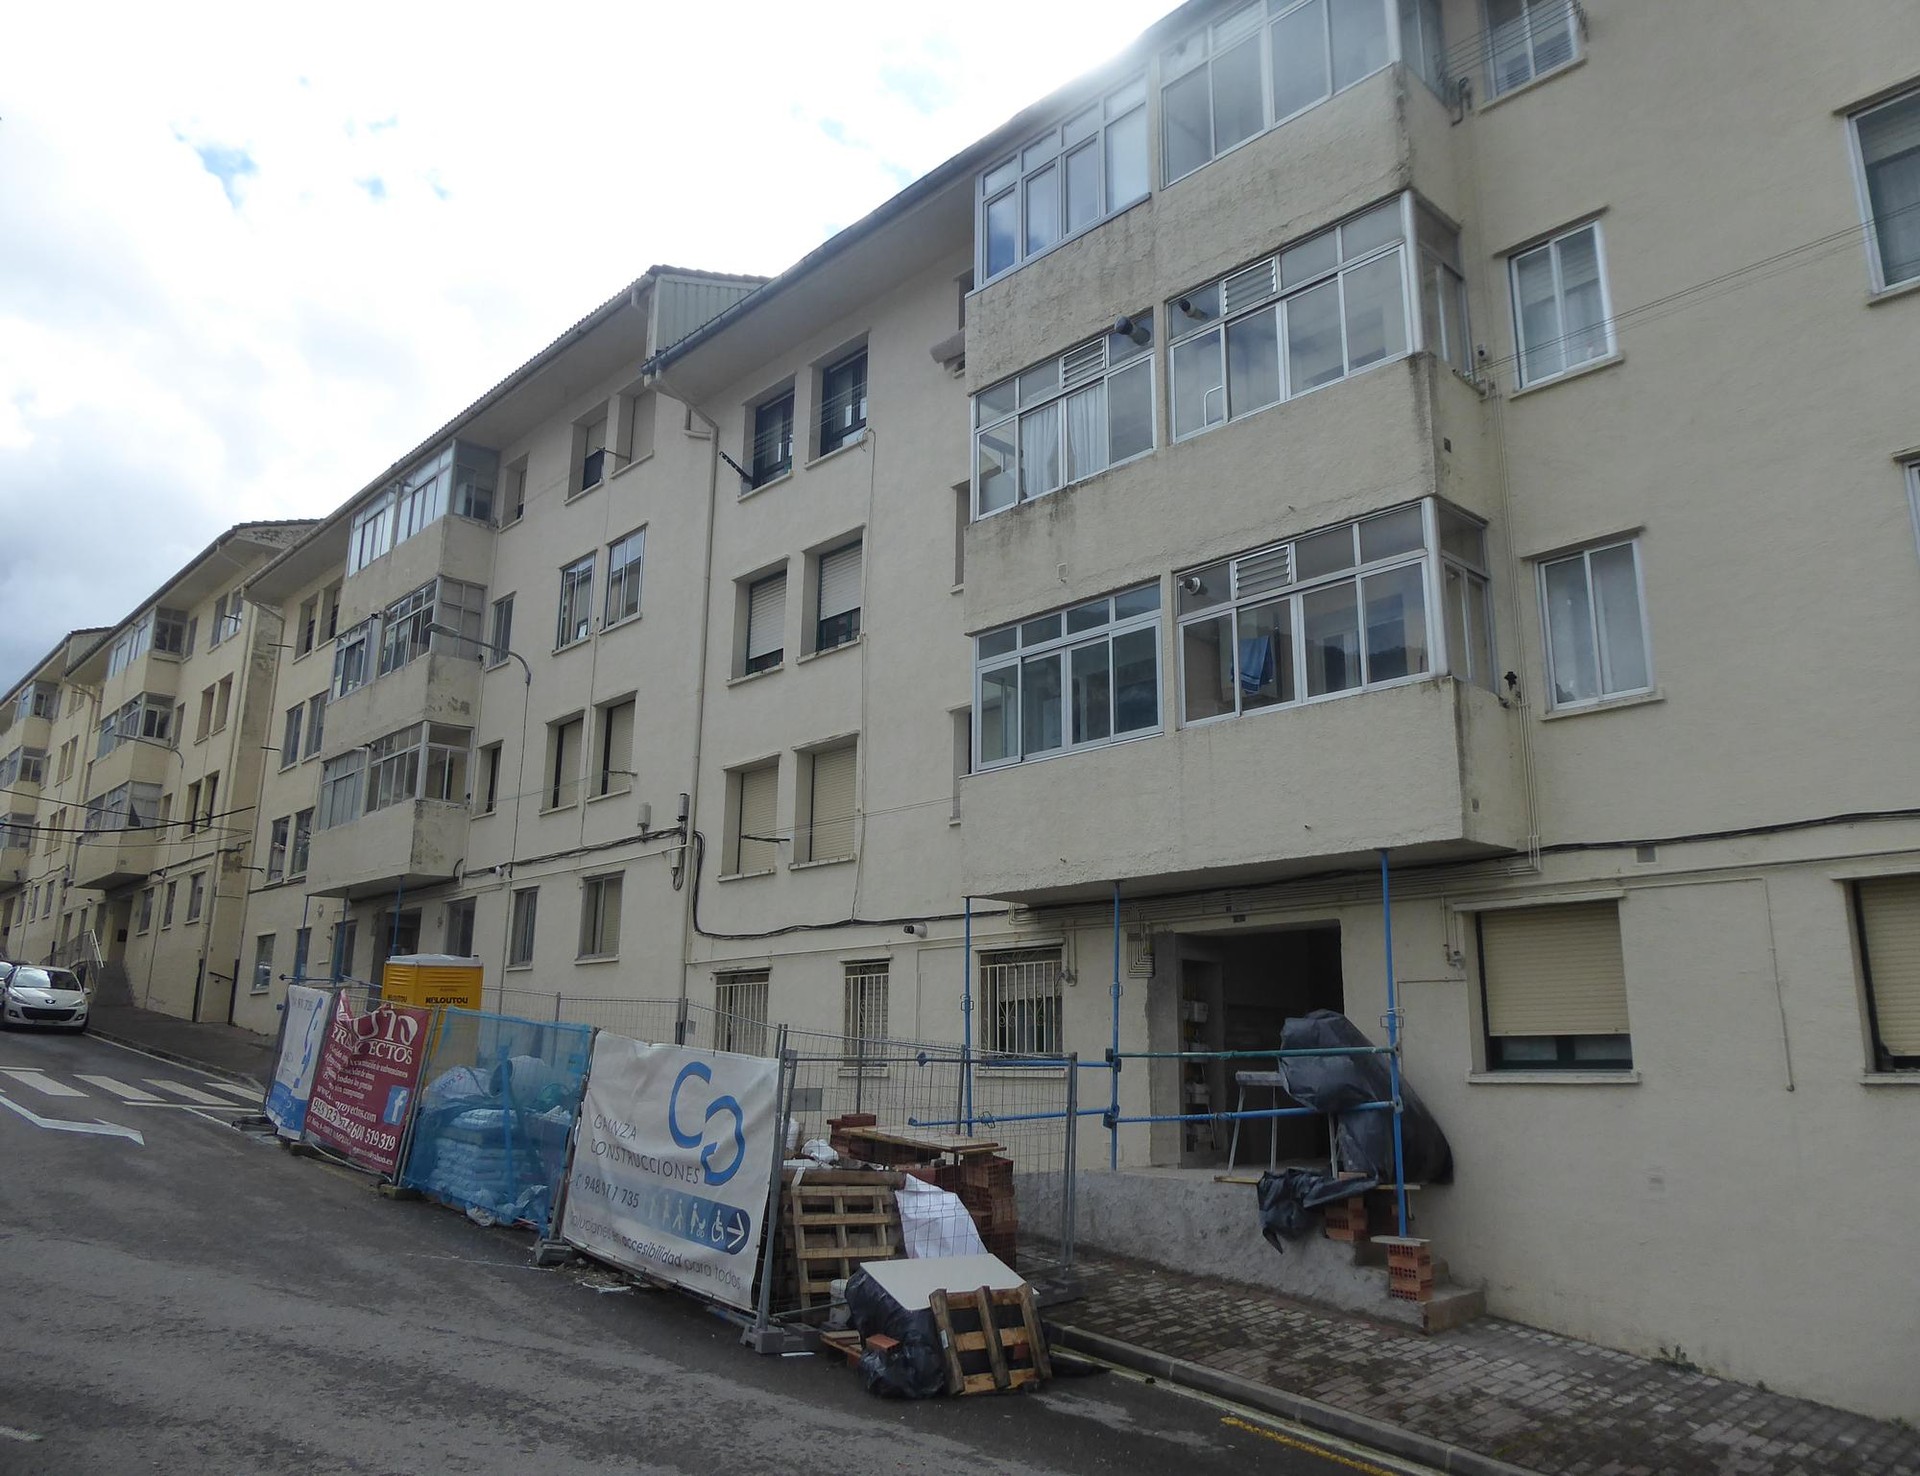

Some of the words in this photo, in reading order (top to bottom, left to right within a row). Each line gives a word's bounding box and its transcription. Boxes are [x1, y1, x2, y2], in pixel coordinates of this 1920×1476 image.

[365, 1128, 380, 1146] 519
[379, 1133, 396, 1151] 319
[590, 1138, 701, 1185] CONSTRUCCIONES
[621, 1236, 682, 1268] accesibilidad
[683, 1257, 712, 1277] para
[715, 1262, 742, 1290] todos
